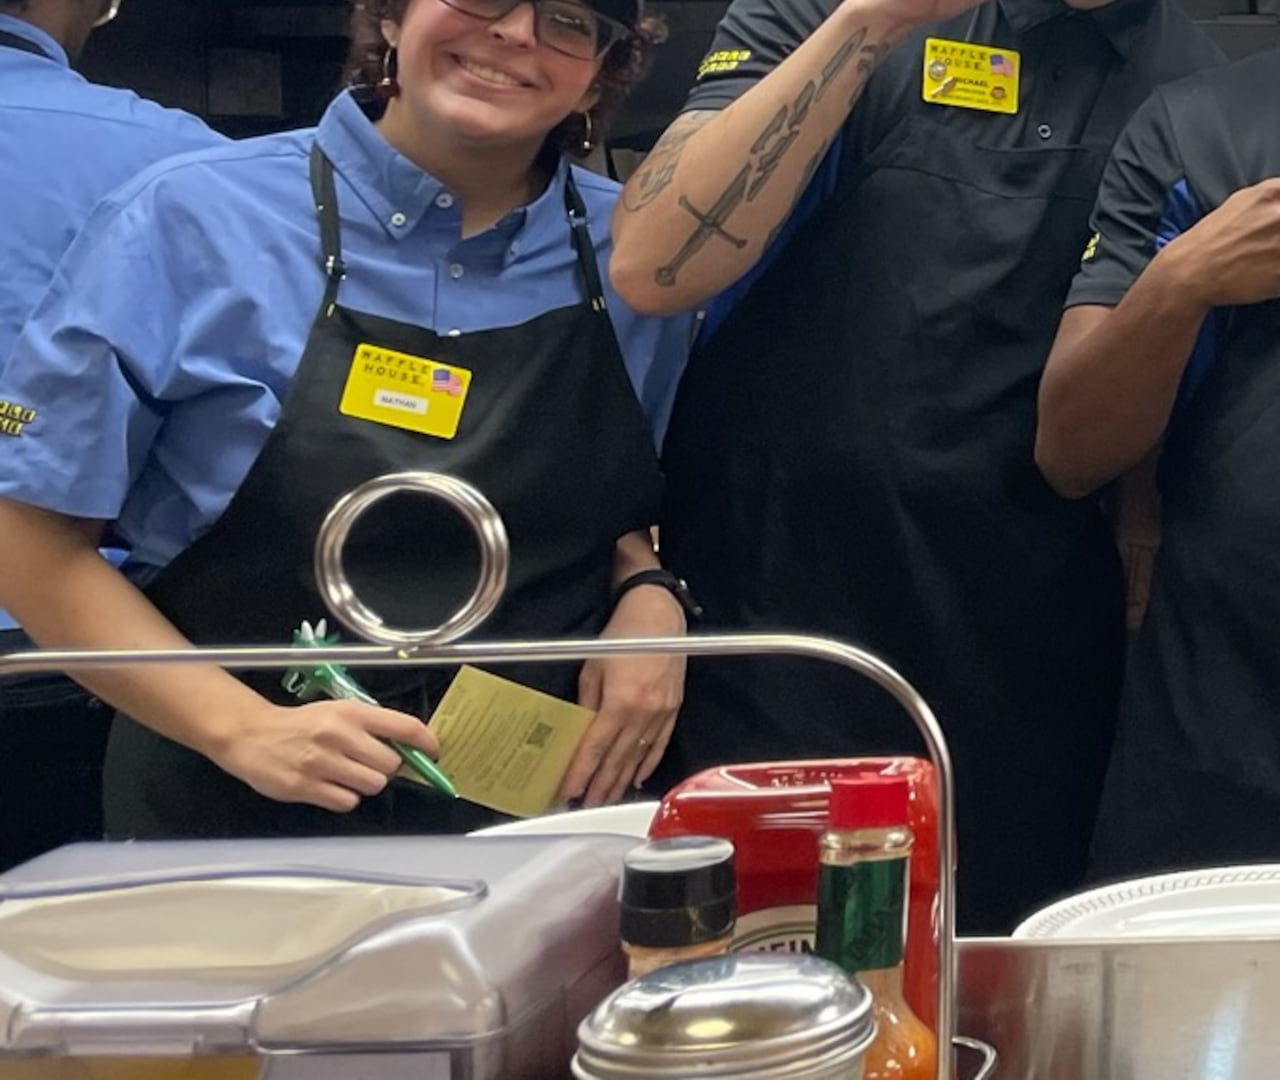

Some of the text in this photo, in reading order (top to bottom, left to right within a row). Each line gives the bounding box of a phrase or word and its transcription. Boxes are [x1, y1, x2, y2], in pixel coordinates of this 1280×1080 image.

[931, 45, 987, 61] WAFFLE
[362, 351, 431, 374] WAFFLE
[381, 395, 417, 409] NATHAN
